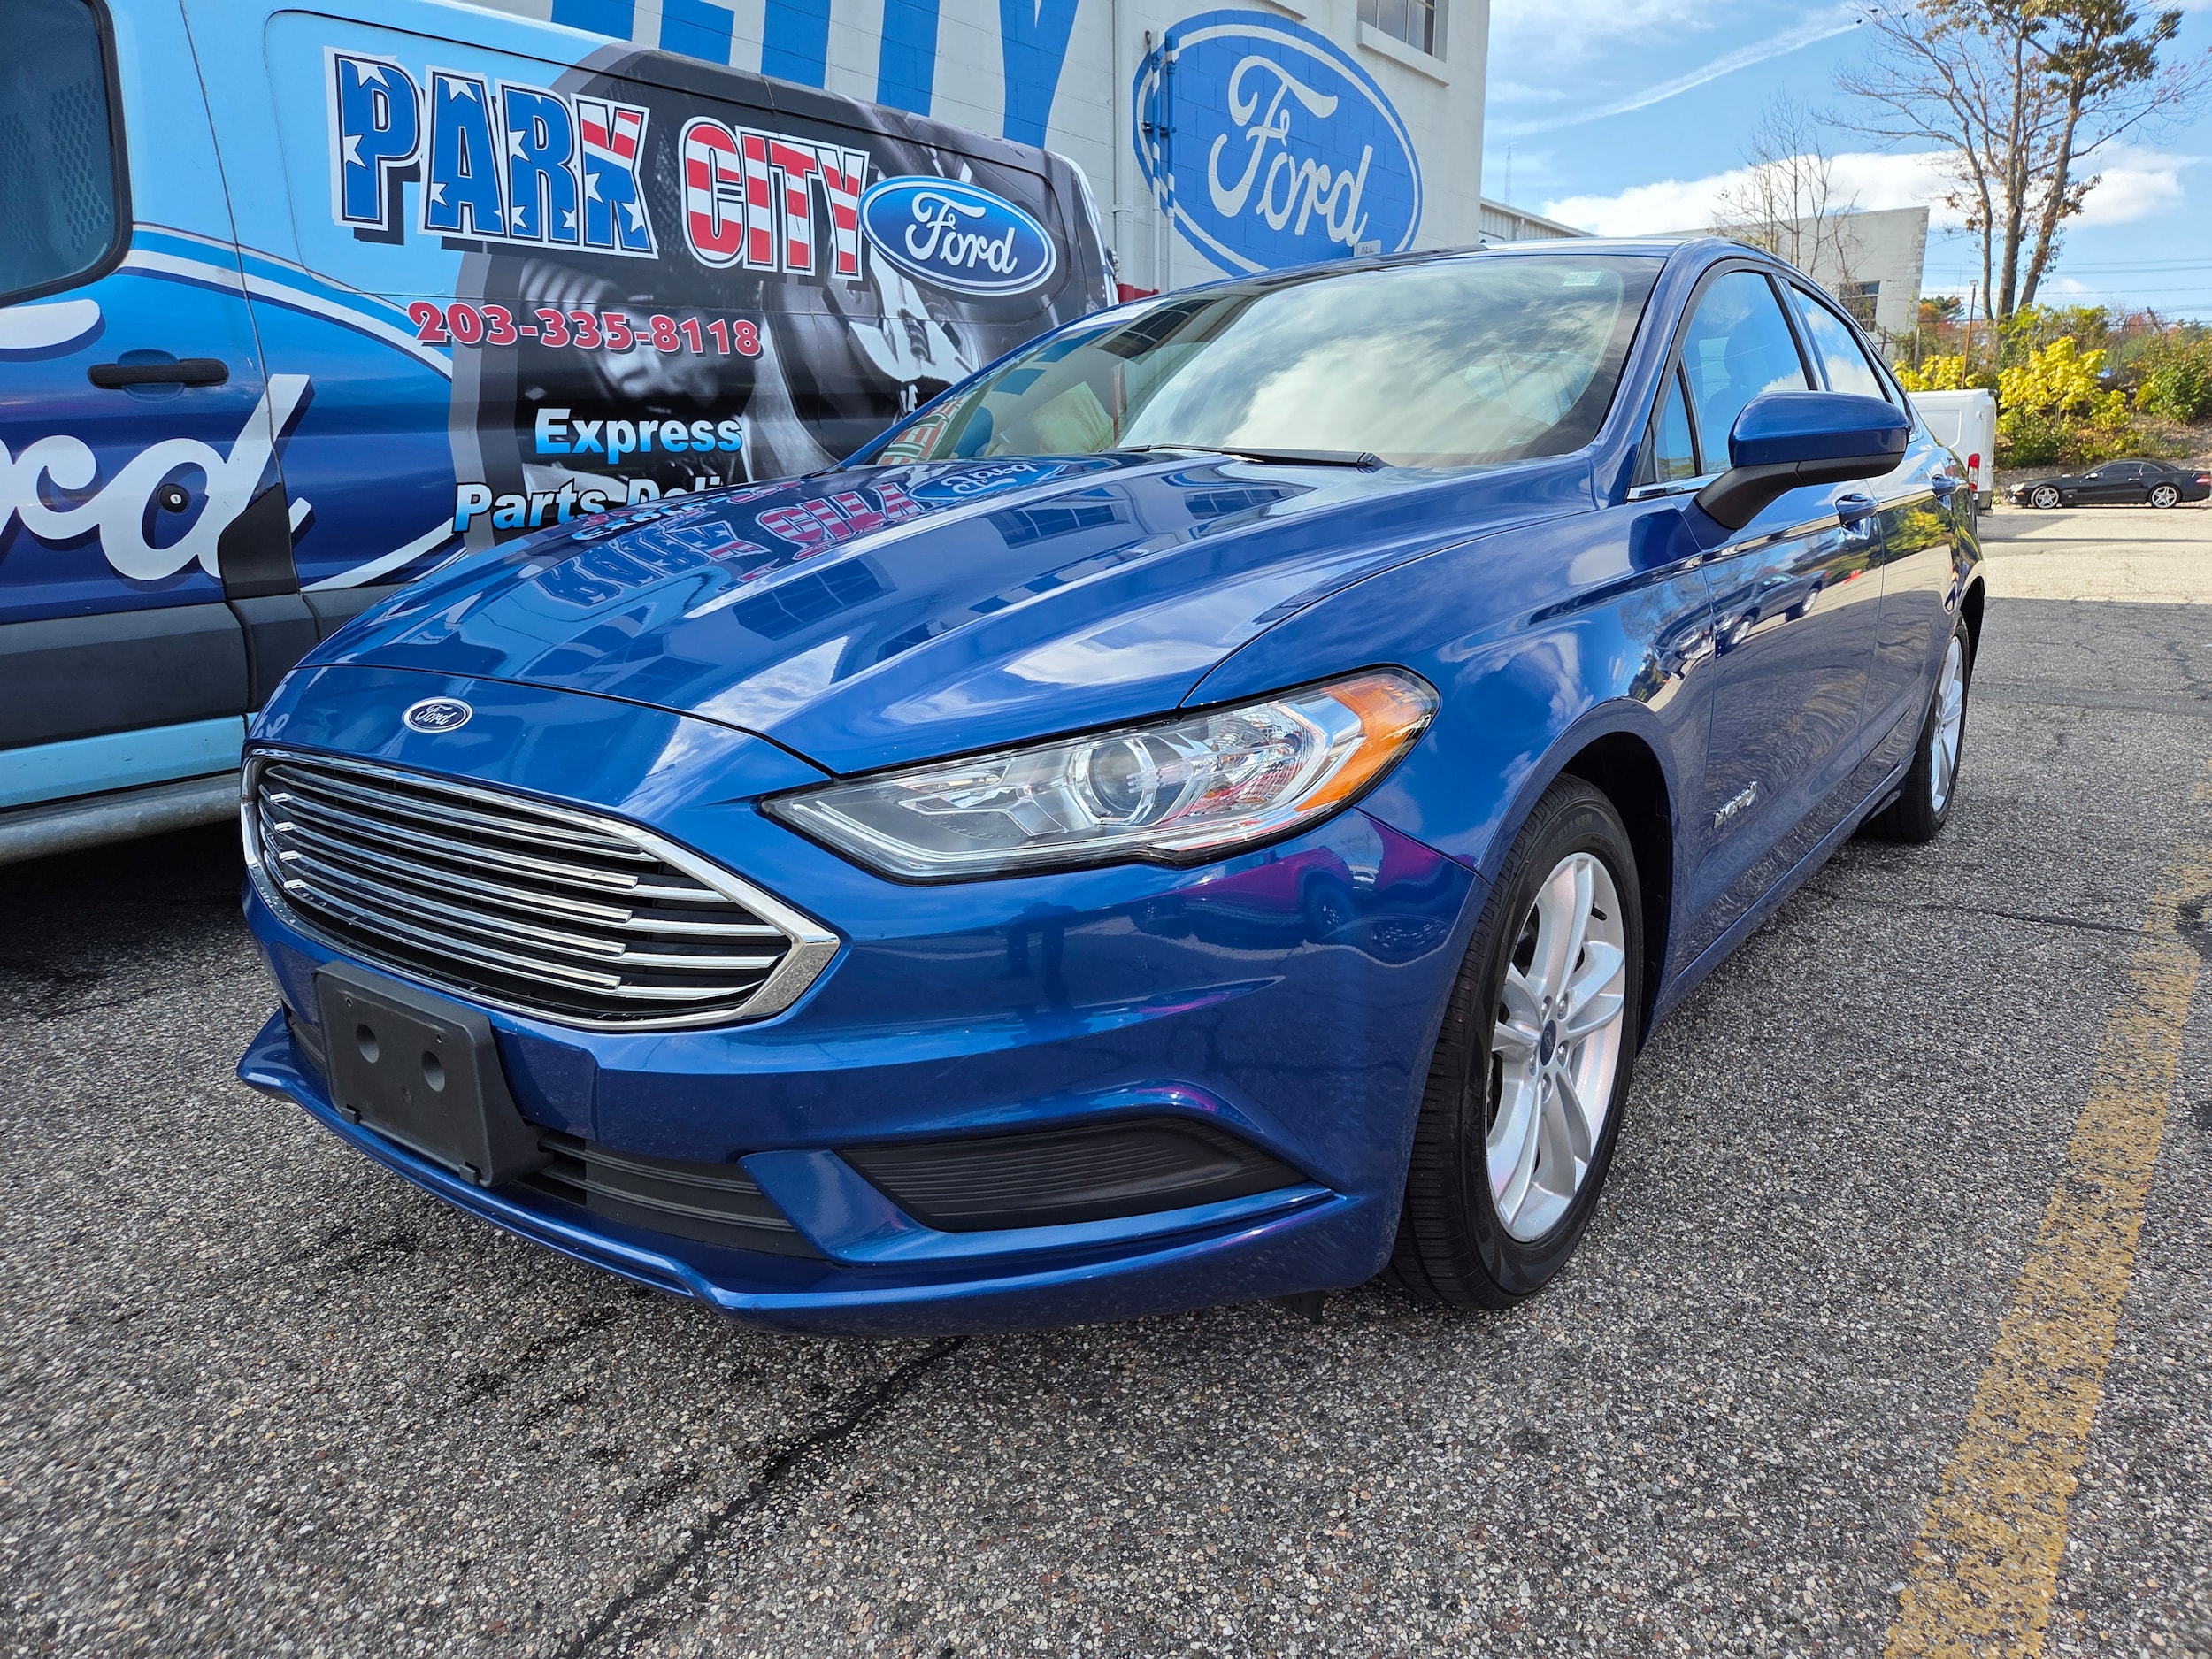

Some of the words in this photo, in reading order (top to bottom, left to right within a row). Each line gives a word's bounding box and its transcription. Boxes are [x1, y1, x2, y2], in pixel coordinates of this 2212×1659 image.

[323, 46, 658, 260] PARK
[679, 115, 870, 281] CITY
[1209, 55, 1373, 247] Ford
[905, 191, 1018, 274] Ford
[407, 301, 763, 357] 203-335-8118
[534, 407, 743, 465] Express
[452, 478, 610, 533] Parts
[414, 704, 457, 725] Ford
